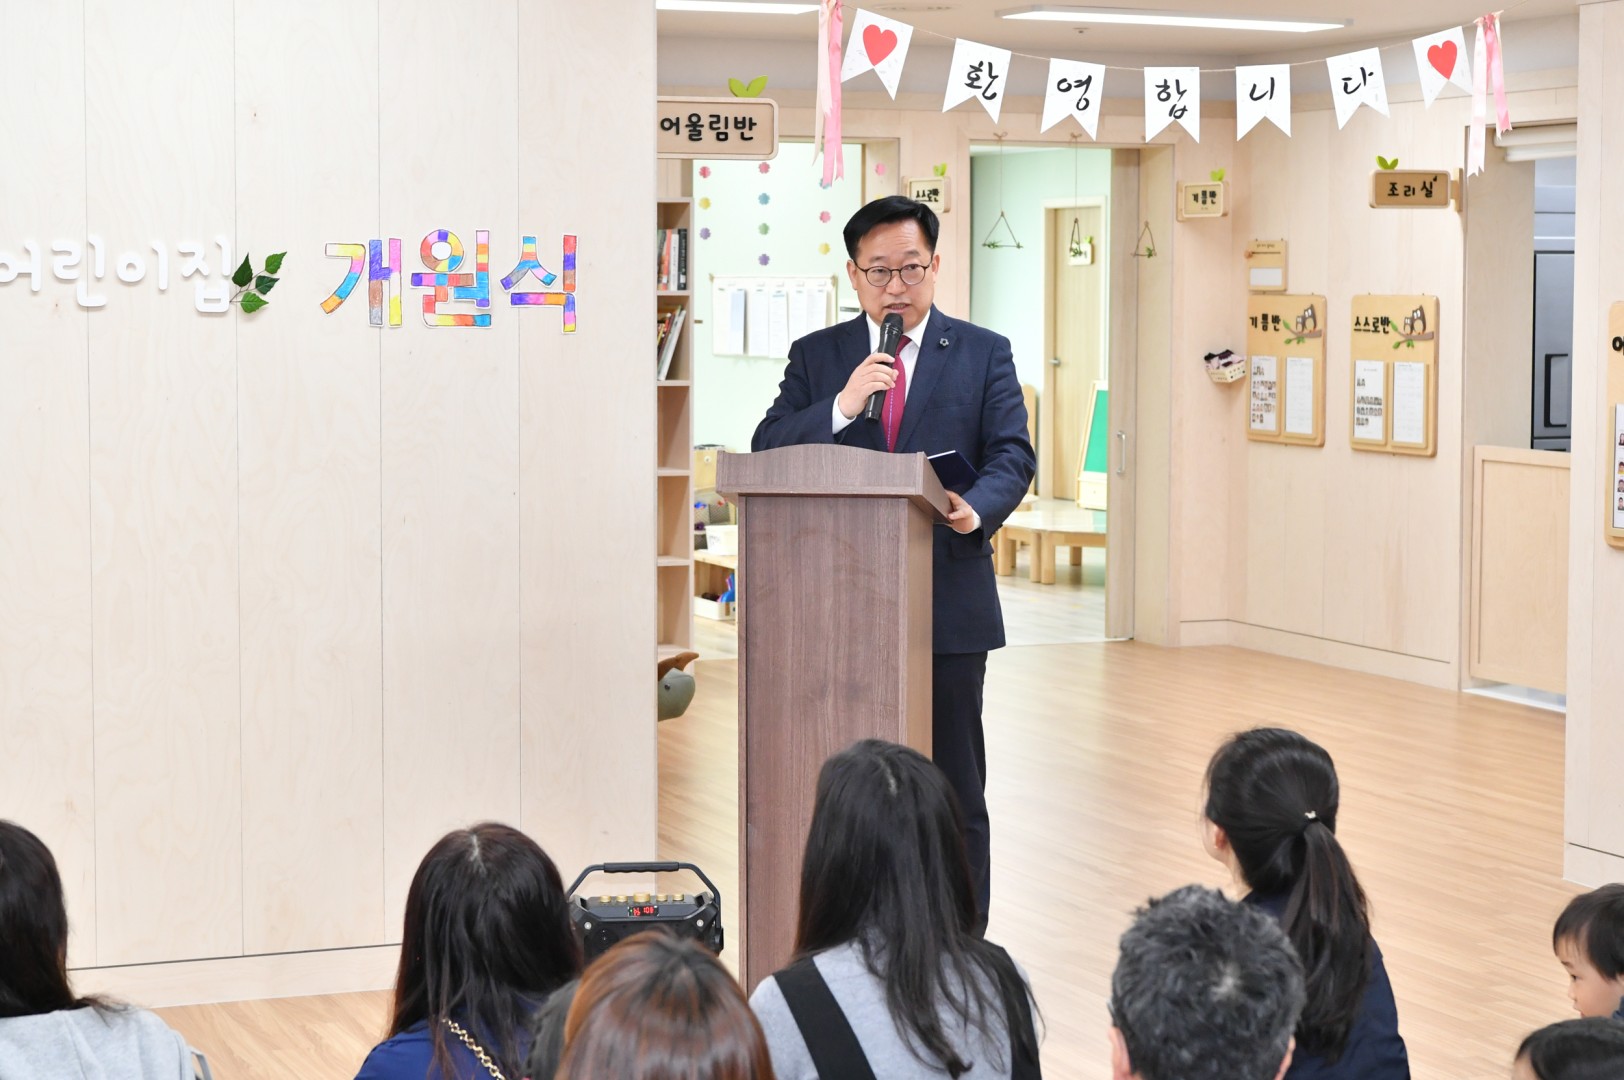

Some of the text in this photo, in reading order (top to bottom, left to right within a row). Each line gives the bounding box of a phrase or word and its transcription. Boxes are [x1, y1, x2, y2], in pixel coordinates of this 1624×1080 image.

[965, 60, 1374, 120] 환영합니다
[660, 112, 758, 142] 어울림반
[1387, 180, 1433, 199] 조리실
[0, 228, 577, 333] 어린이집 개원식
[1353, 315, 1391, 335] 스스로반
